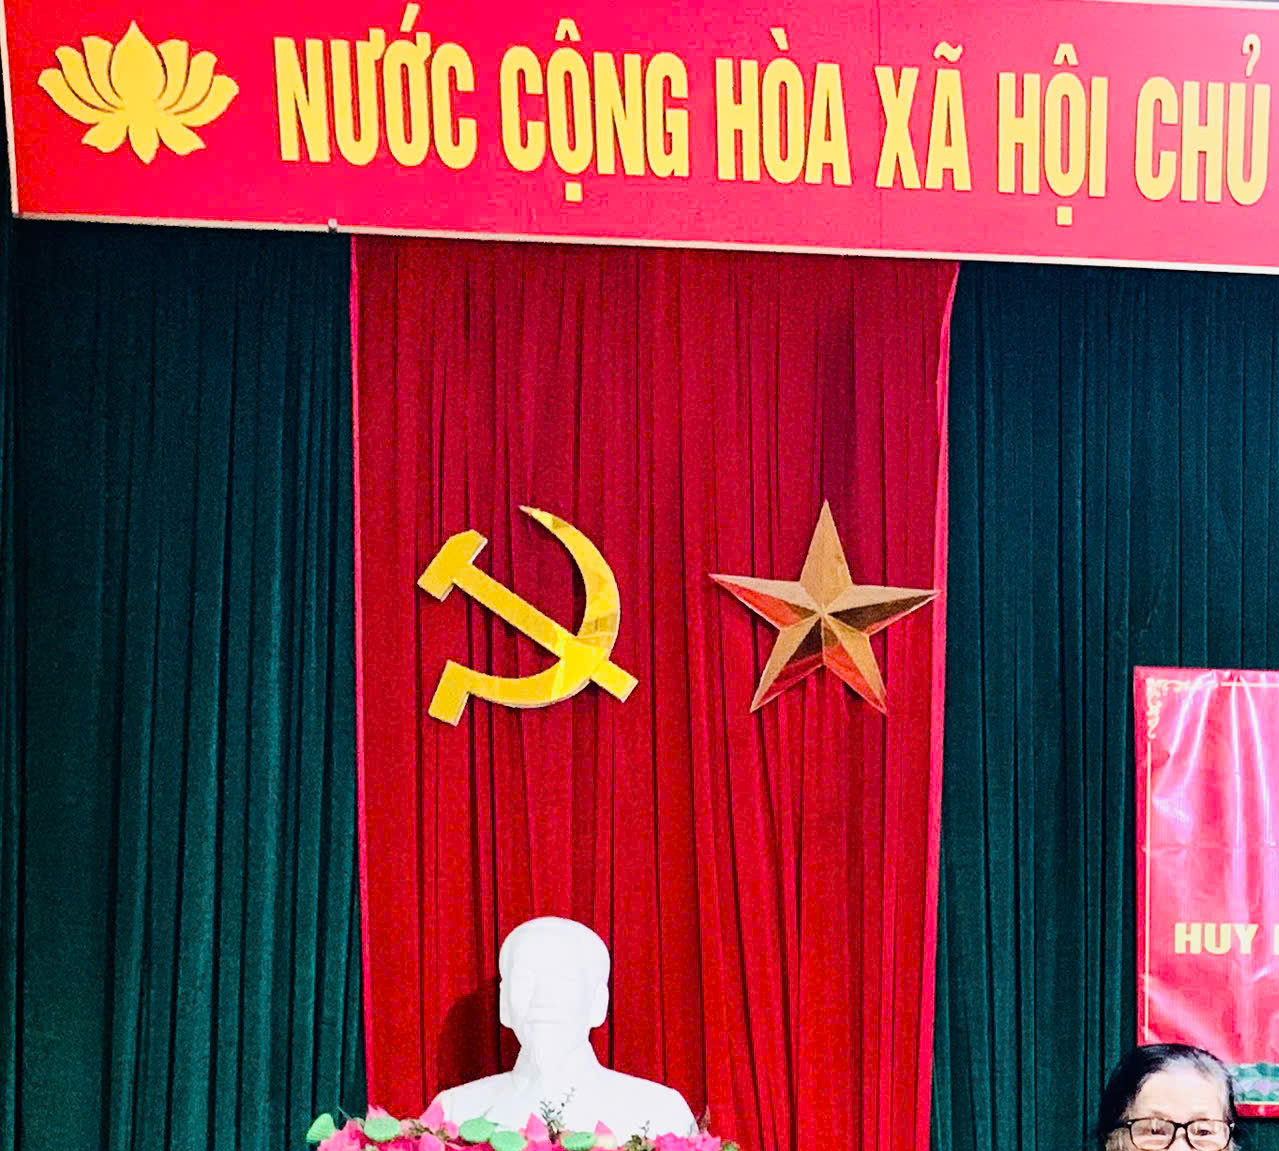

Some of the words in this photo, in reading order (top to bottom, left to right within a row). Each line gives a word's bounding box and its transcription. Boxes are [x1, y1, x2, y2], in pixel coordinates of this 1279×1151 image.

[274, 3, 478, 170] NƯỚC
[500, 19, 690, 203] CỘNG
[716, 27, 852, 187] HÒA
[874, 41, 973, 193] XÃ
[997, 43, 1110, 227] HỘI
[1135, 33, 1272, 206] CHỦ
[1174, 922, 1259, 955] HUY
